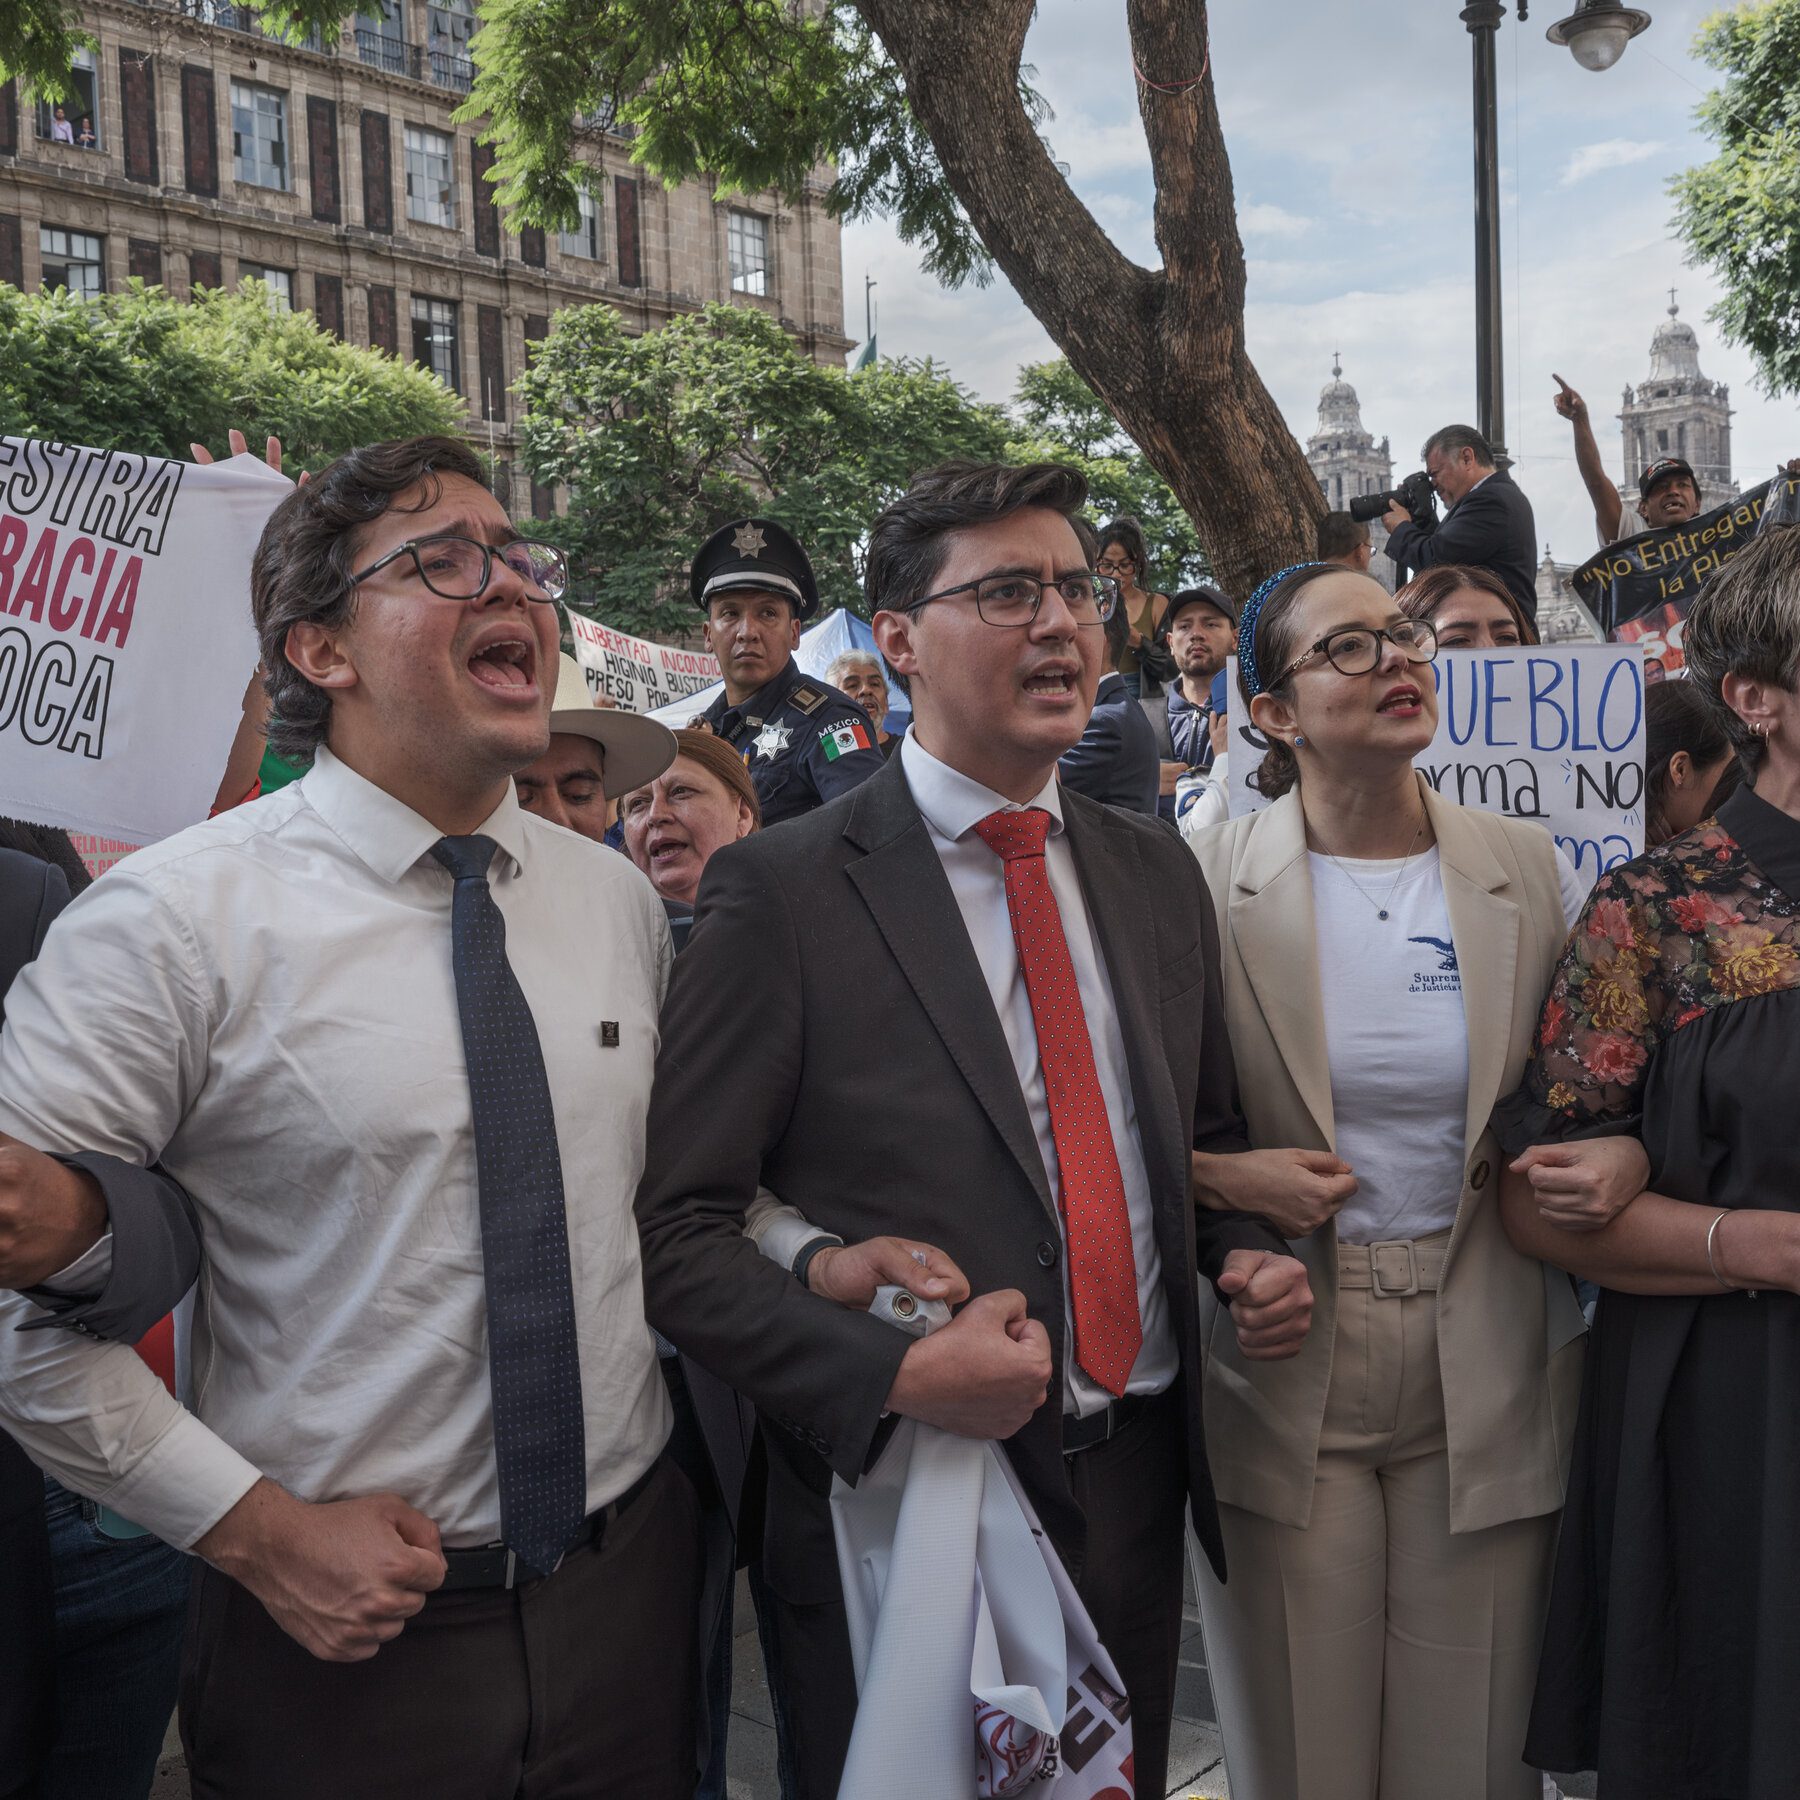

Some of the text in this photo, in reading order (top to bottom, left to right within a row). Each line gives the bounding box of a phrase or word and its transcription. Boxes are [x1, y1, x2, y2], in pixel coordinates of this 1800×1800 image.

[1659, 577, 1685, 598] la
[571, 616, 651, 665] ¡LIBERTAD
[586, 667, 634, 701] PRESO
[604, 651, 658, 687] HIGINIO
[1430, 658, 1642, 752] UEBLO
[817, 717, 860, 739] MÉXICO
[1576, 761, 1644, 810] NO
[1409, 983, 1420, 993] de
[1422, 983, 1457, 992] Justicia
